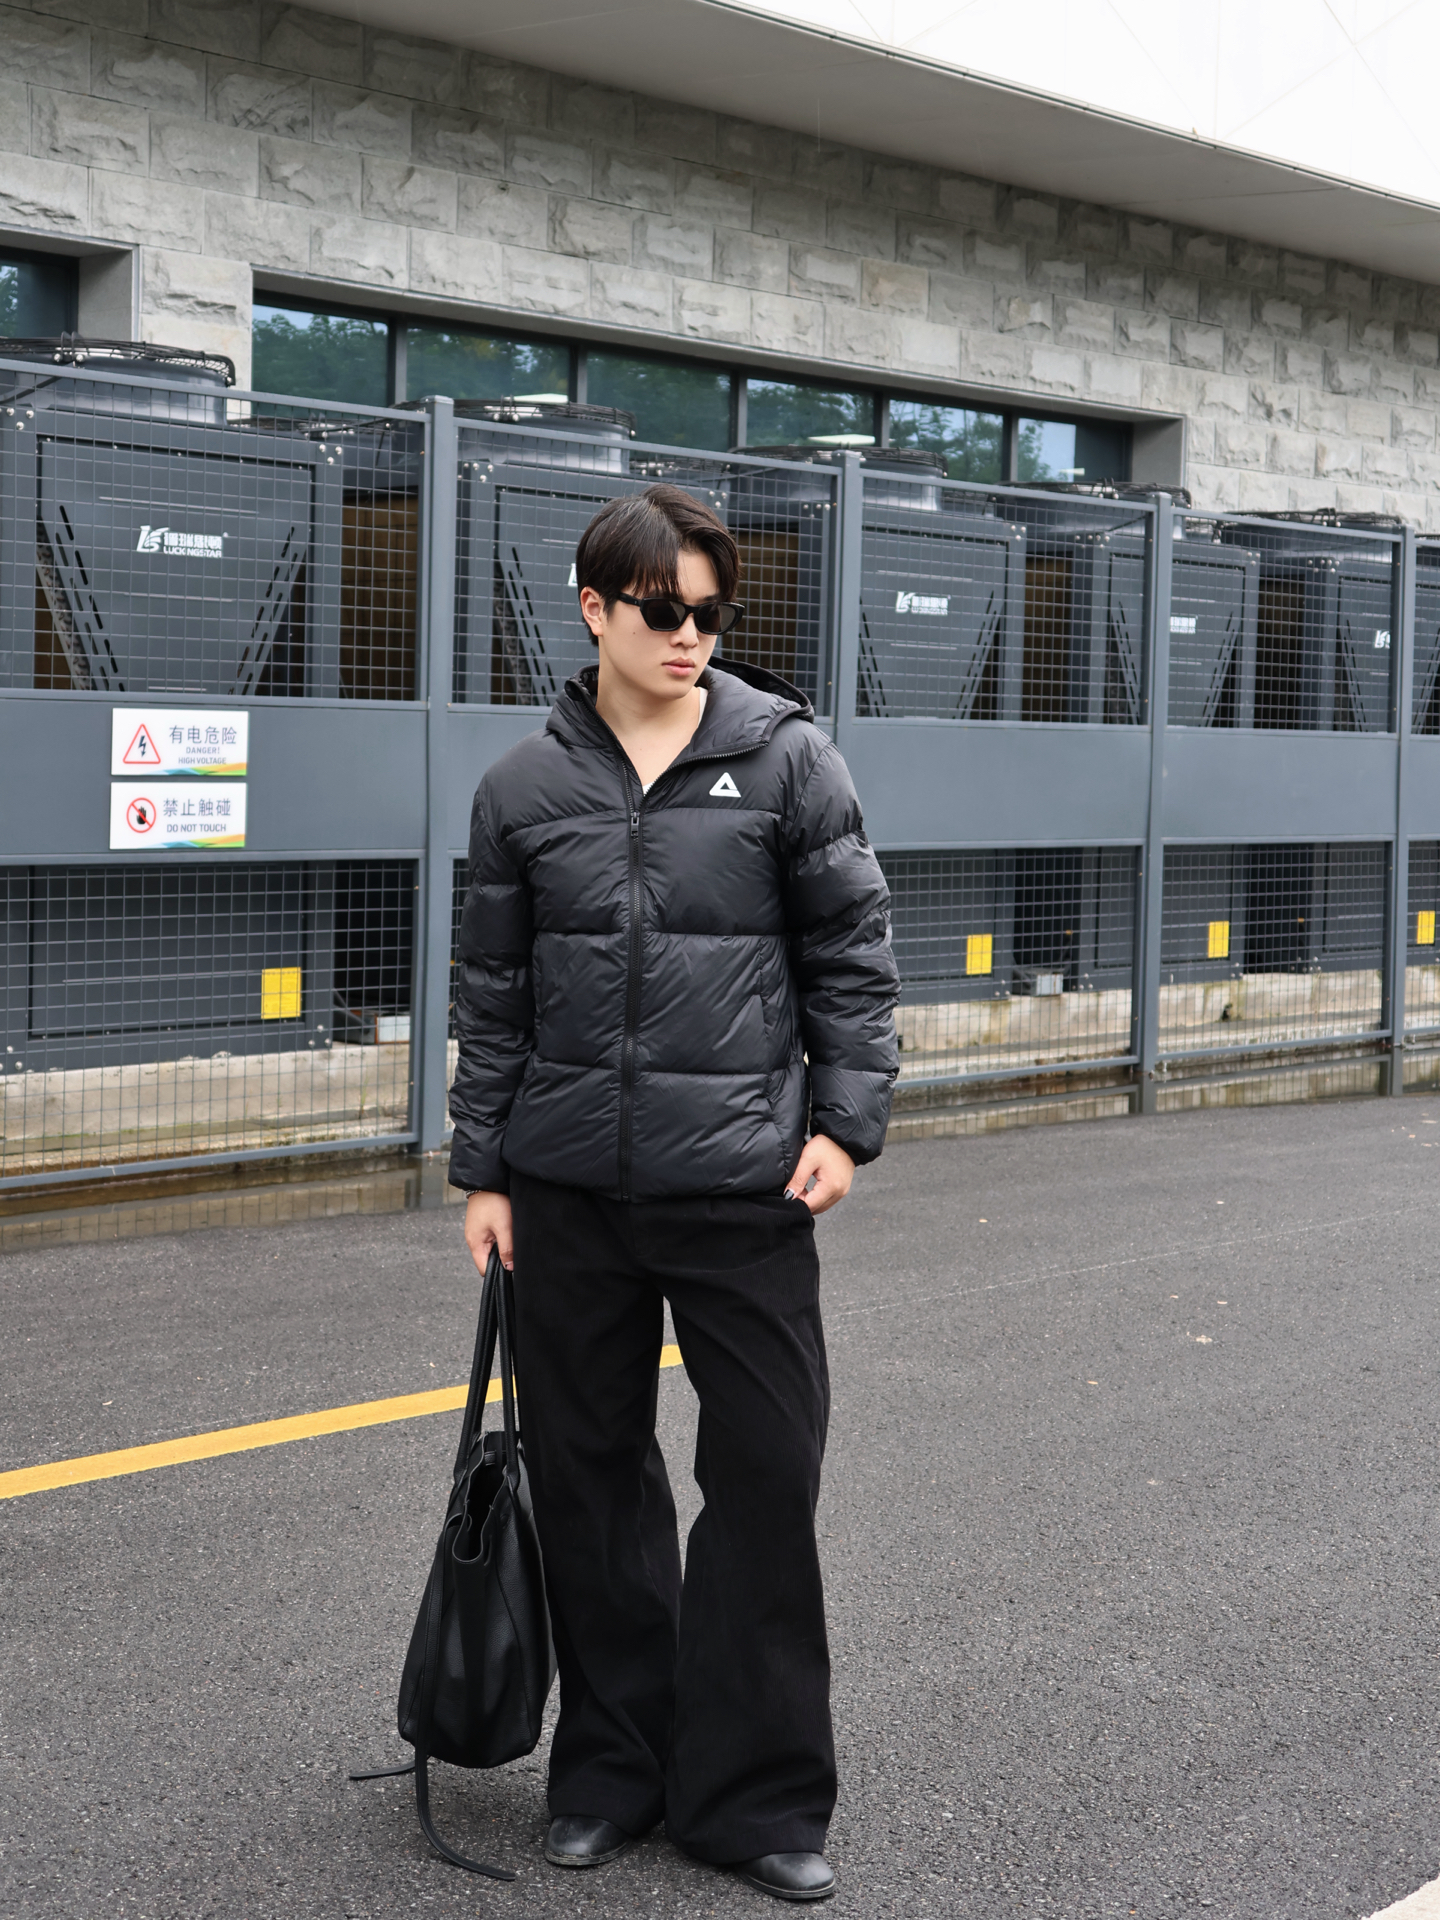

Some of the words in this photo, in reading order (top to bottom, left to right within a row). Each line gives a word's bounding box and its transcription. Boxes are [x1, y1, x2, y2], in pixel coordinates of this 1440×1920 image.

[163, 546, 222, 558] LUCKNGSTAR
[169, 725, 237, 745] 有电危险
[186, 746, 220, 755] DANGER!
[196, 757, 226, 765] VOLTAGE
[163, 798, 231, 817] 禁止触碰
[166, 824, 178, 833] DO
[180, 823, 197, 833] NOT
[199, 823, 226, 833] TOUCH
